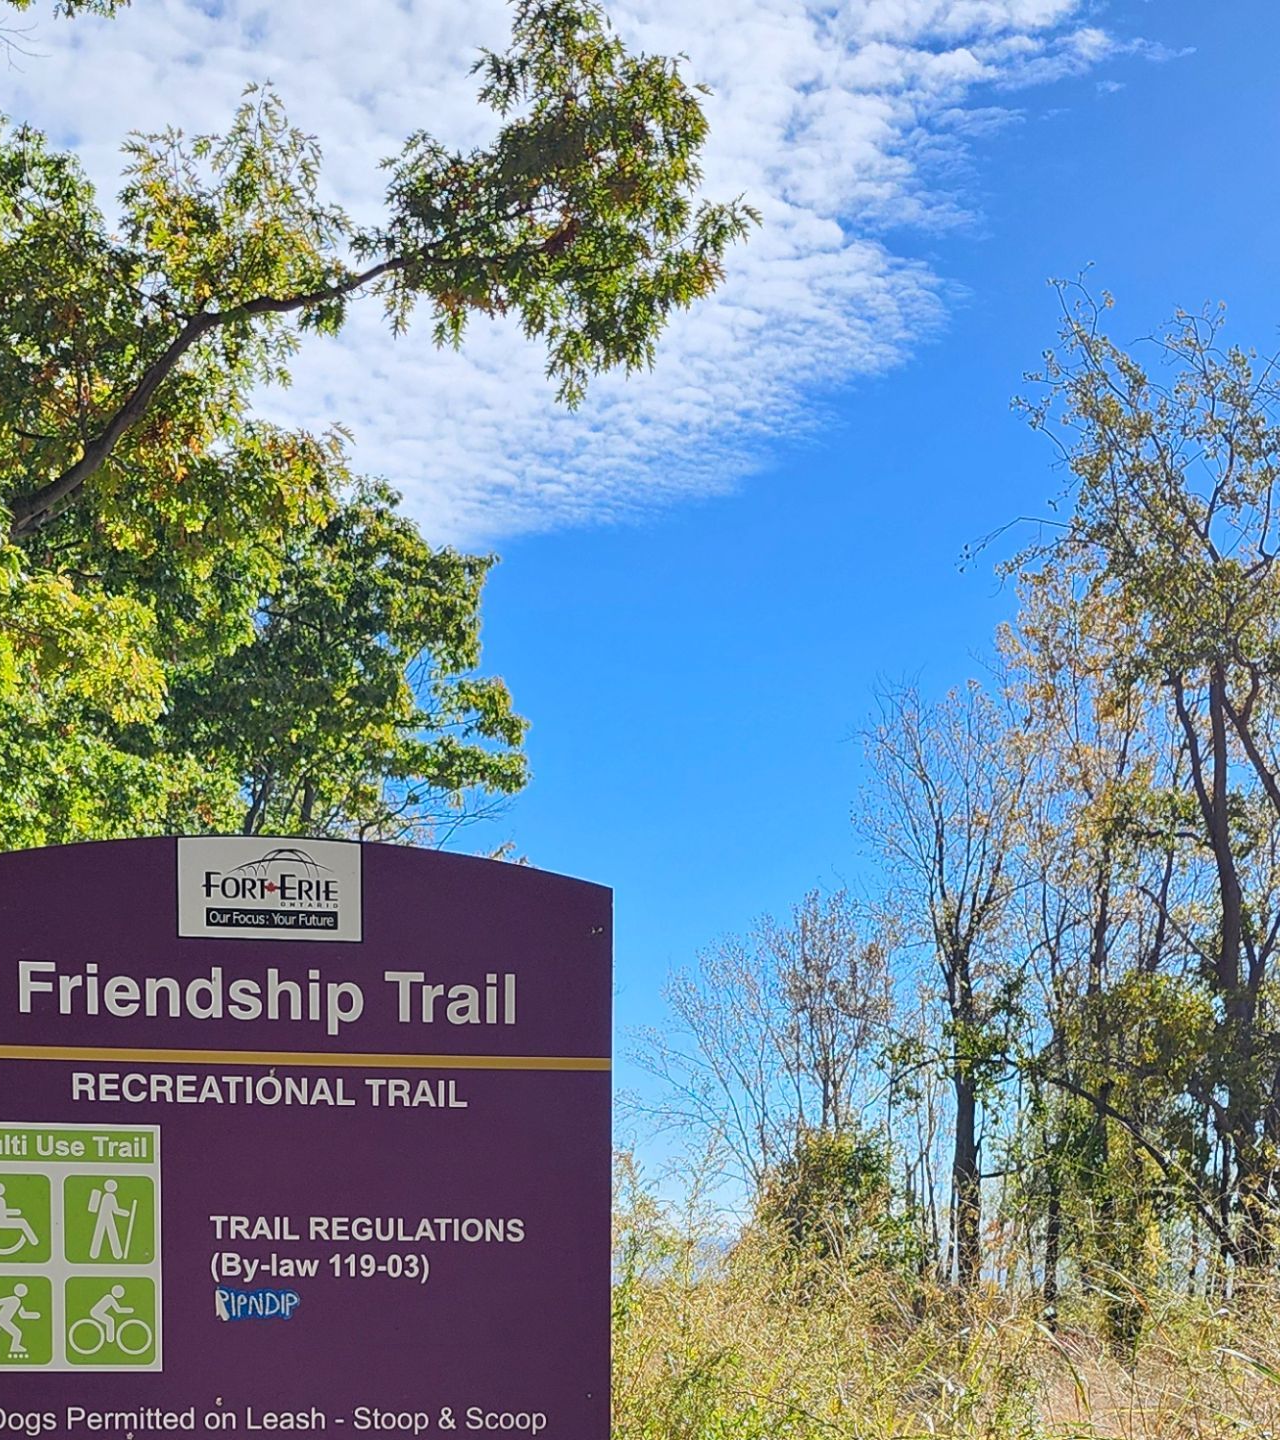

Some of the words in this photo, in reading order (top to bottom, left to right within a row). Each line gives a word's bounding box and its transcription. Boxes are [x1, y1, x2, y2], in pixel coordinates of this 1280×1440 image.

[202, 871, 268, 899] FORT
[279, 874, 338, 901] ERIE
[209, 911, 231, 924] Our
[232, 912, 270, 925] Focus:
[272, 913, 297, 925] Your
[298, 914, 335, 927] Future
[18, 960, 364, 1036] Friendship
[384, 971, 516, 1025] Trail
[72, 1072, 356, 1106] RECREATIONAL
[364, 1078, 468, 1108] TRAIL
[36, 1134, 86, 1157] Use
[92, 1136, 148, 1158] Trail
[209, 1215, 300, 1241] TRAIL
[309, 1216, 525, 1242] REGULATIONS
[211, 1252, 320, 1283] (By-law
[329, 1253, 429, 1284] 119-03)
[67, 1406, 195, 1430] Permitted
[204, 1412, 236, 1430] on
[247, 1406, 326, 1430] Leash
[353, 1406, 429, 1435] Stoop
[438, 1406, 457, 1430] &
[465, 1406, 547, 1435] Scoop
